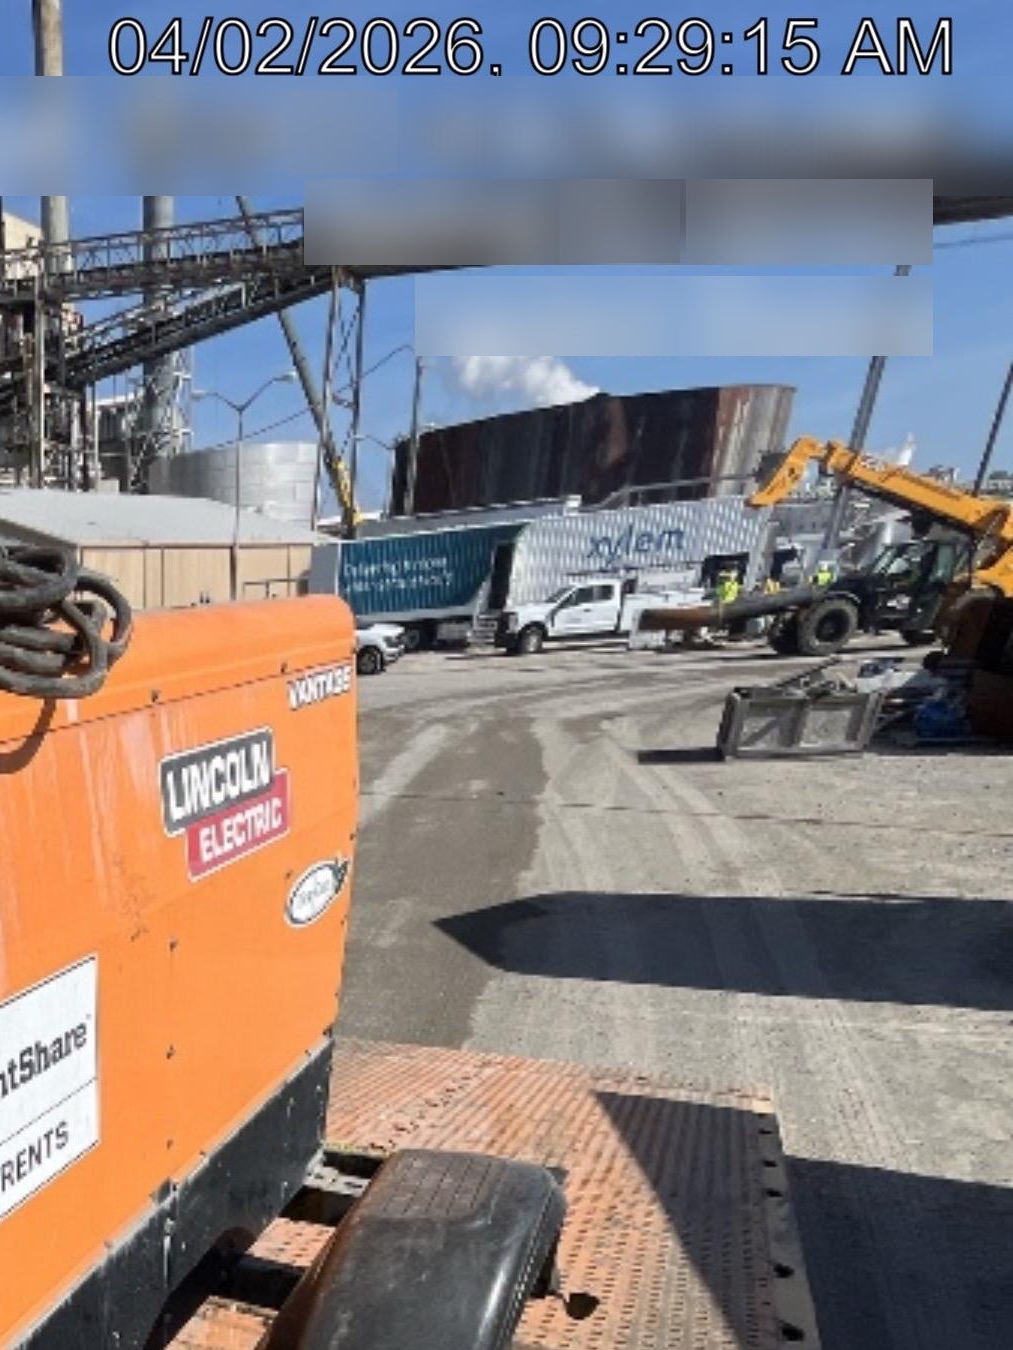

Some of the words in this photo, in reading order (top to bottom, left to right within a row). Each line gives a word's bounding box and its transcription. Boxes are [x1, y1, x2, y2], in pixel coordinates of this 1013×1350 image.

[587, 525, 684, 567] xylem
[287, 665, 351, 711] VANTAGE
[166, 739, 271, 822] LINCOLN
[198, 797, 283, 863] ELECTRIC
